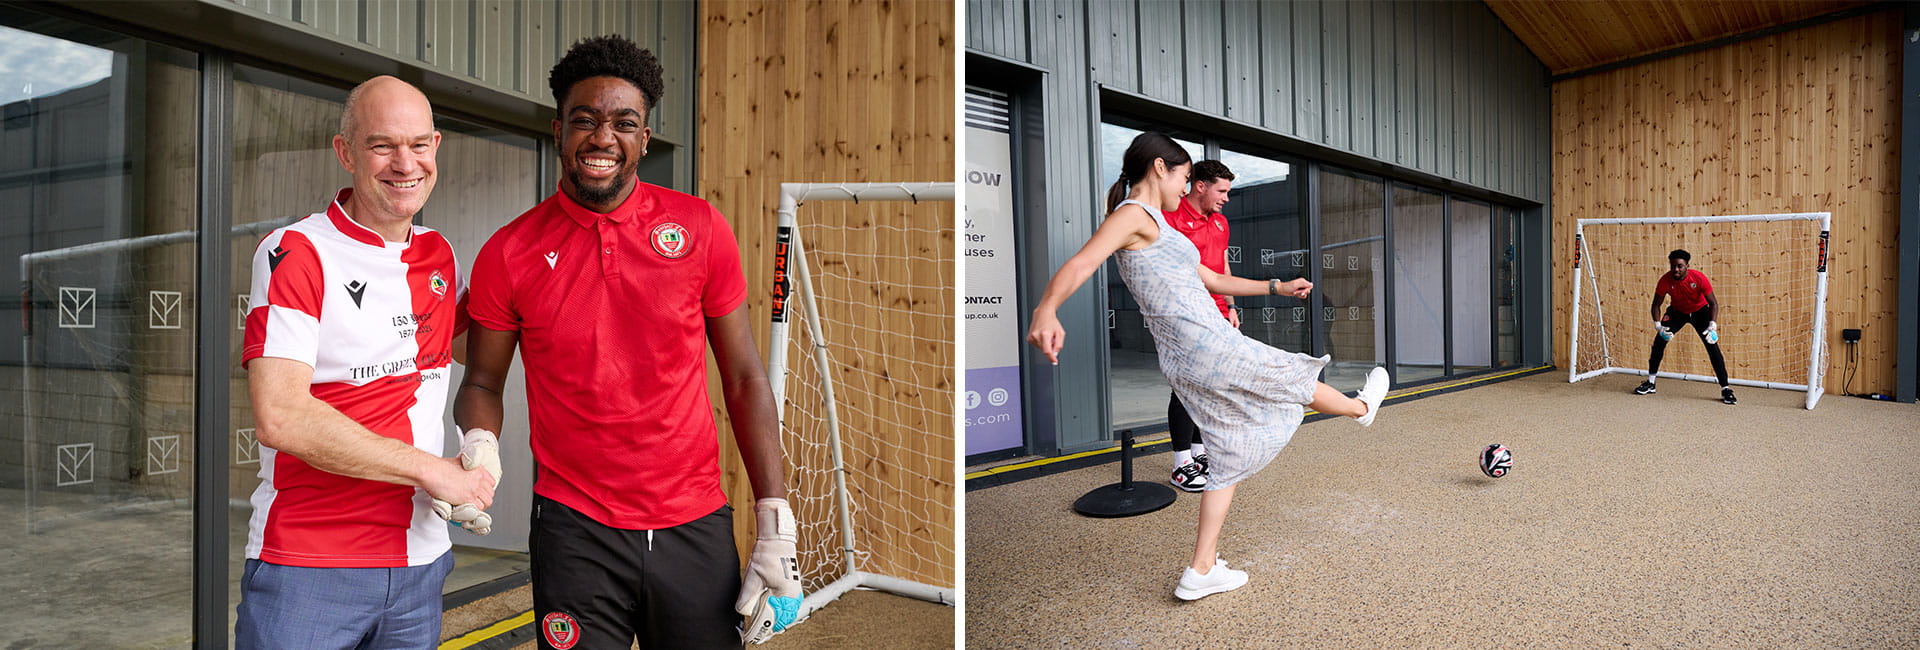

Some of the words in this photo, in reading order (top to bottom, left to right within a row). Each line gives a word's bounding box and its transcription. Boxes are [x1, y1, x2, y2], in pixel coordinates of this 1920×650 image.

[965, 169, 1001, 187] OW
[965, 248, 994, 258] uses
[773, 243, 786, 310] URBAN
[392, 316, 408, 326] 150
[350, 365, 379, 379] THE
